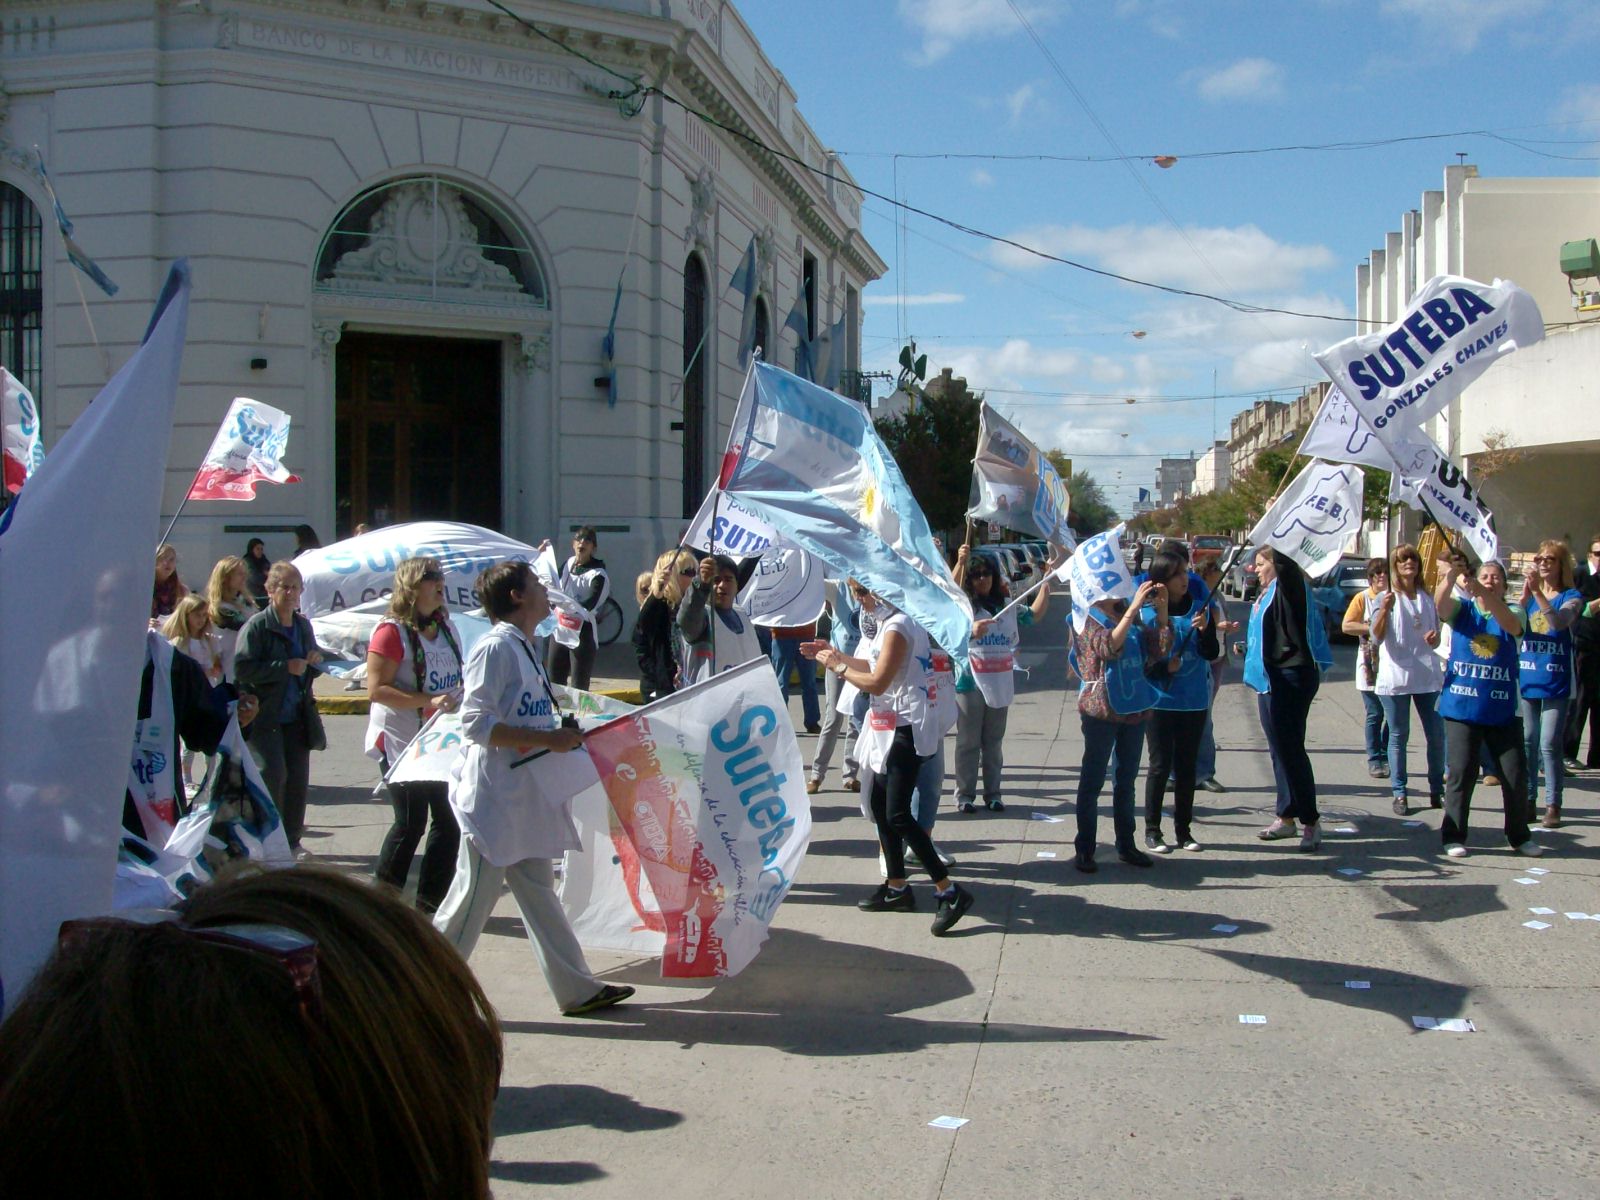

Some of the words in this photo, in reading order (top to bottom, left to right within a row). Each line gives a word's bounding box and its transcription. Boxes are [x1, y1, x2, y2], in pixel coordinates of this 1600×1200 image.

[252, 24, 326, 50] BANCO
[338, 39, 361, 56] DE
[372, 46, 392, 61] LA
[404, 47, 483, 76] NACION
[1348, 288, 1496, 401] SUTEBA
[1374, 361, 1454, 429] GONZALES
[1455, 319, 1509, 365] CHAVES
[1423, 483, 1478, 528] NZALES
[707, 516, 771, 555] SUT
[1083, 532, 1123, 592] EBA
[330, 590, 346, 612] A
[428, 669, 462, 692] Suteb
[1453, 661, 1511, 682] SUTEBA
[1546, 663, 1565, 673] CTA
[1450, 684, 1478, 697] CTERA
[1490, 690, 1509, 700] CTA
[704, 798, 720, 811] de
[713, 813, 727, 829] la
